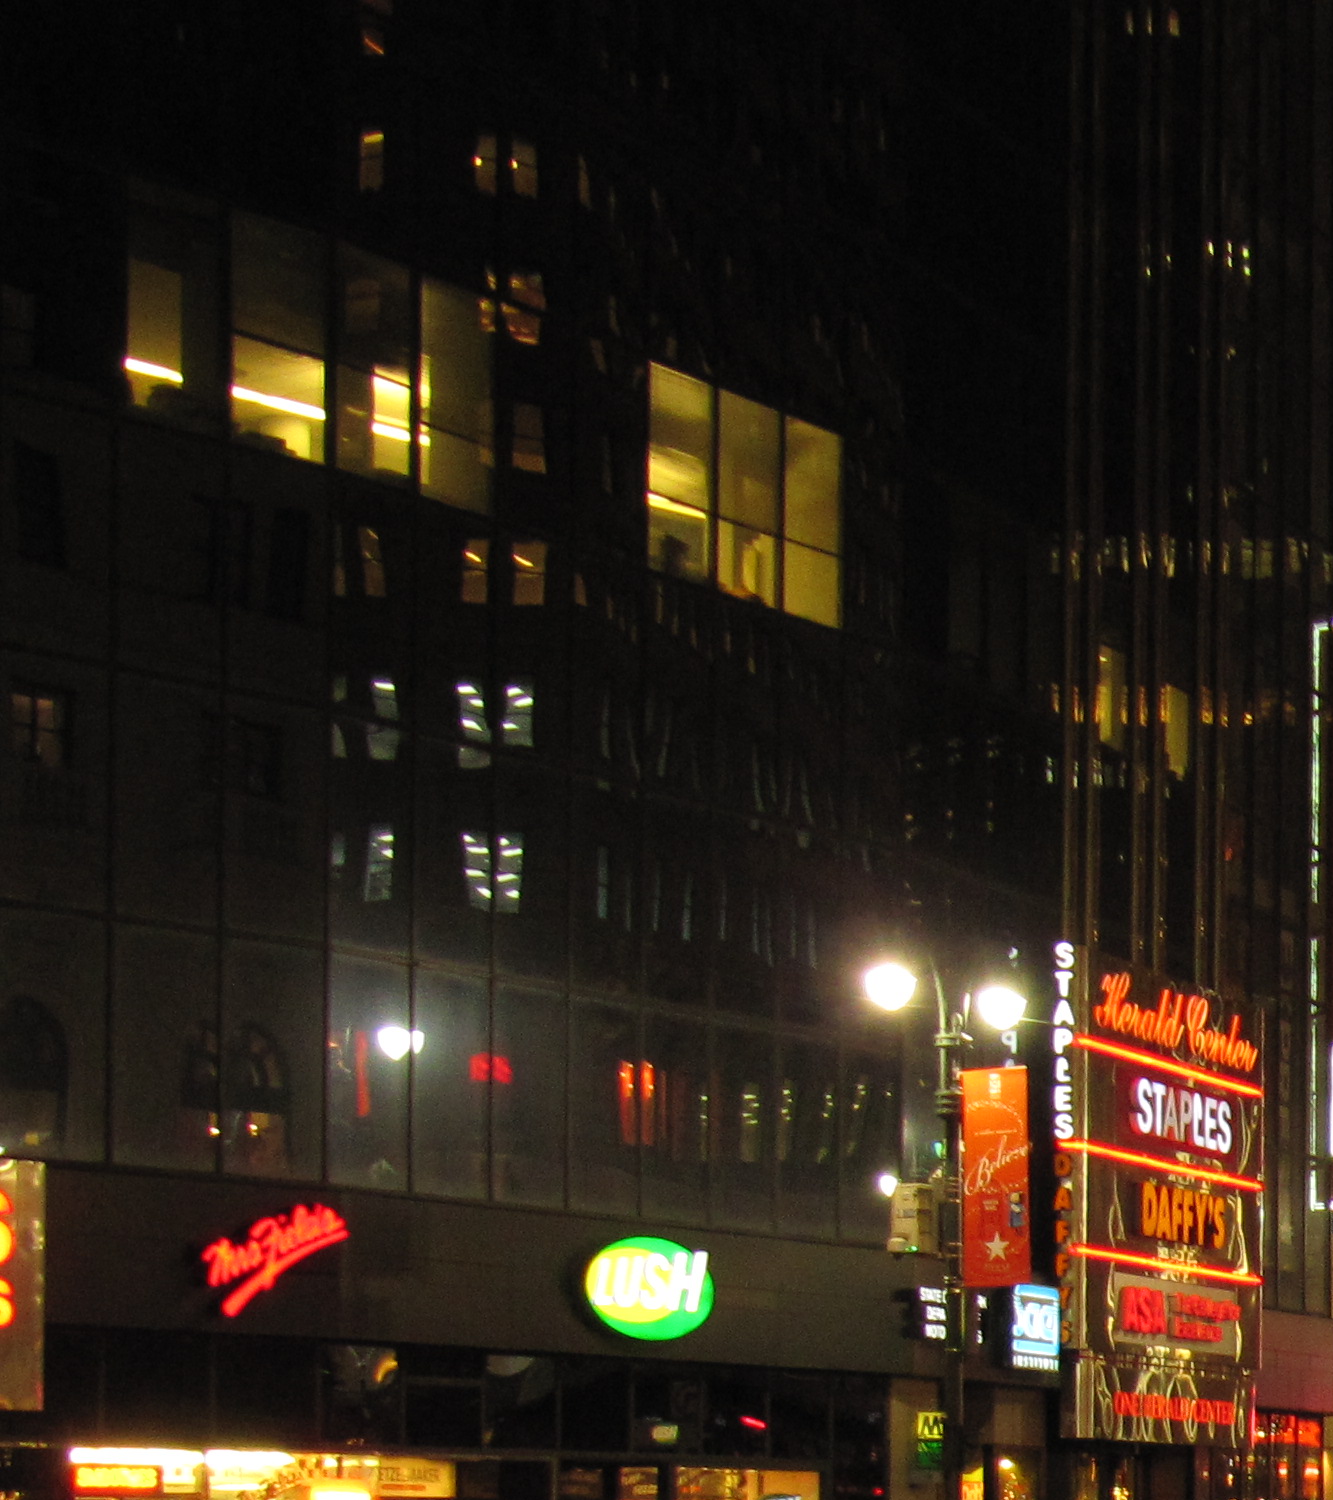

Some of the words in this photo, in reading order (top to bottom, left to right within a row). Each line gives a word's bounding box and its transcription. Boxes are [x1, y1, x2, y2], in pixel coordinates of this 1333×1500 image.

[1053, 941, 1074, 1140] STAPLES
[1093, 972, 1185, 1049] Herald
[1187, 995, 1258, 1072] Center
[1136, 1077, 1233, 1155] STAPLES
[1141, 1181, 1227, 1249] DAFFY'S
[590, 1250, 708, 1313] LUSH
[1120, 1286, 1167, 1335] ASA
